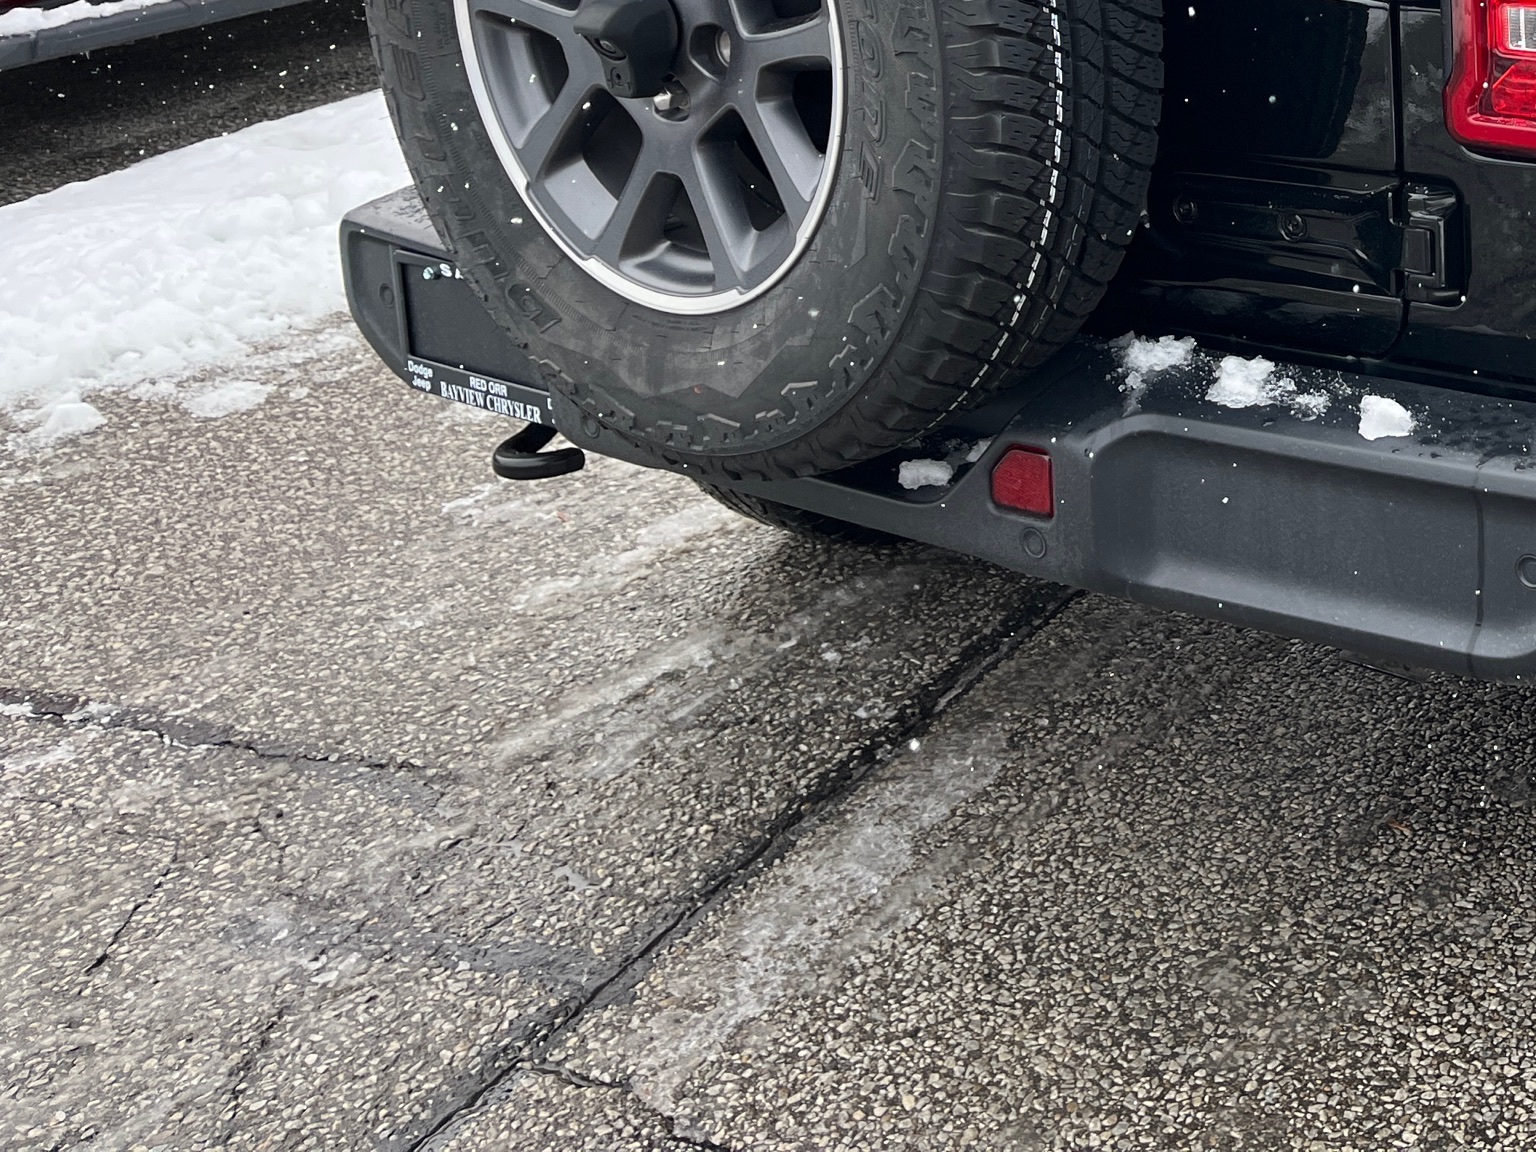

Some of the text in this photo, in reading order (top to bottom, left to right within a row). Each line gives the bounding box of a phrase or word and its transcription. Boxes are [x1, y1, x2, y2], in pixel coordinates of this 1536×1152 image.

[407, 360, 433, 378] Dodge
[412, 375, 431, 392] Jeep
[469, 376, 507, 397] RED ORR
[440, 380, 485, 407] BAYVIEW
[486, 394, 542, 424] CHRYSLER
